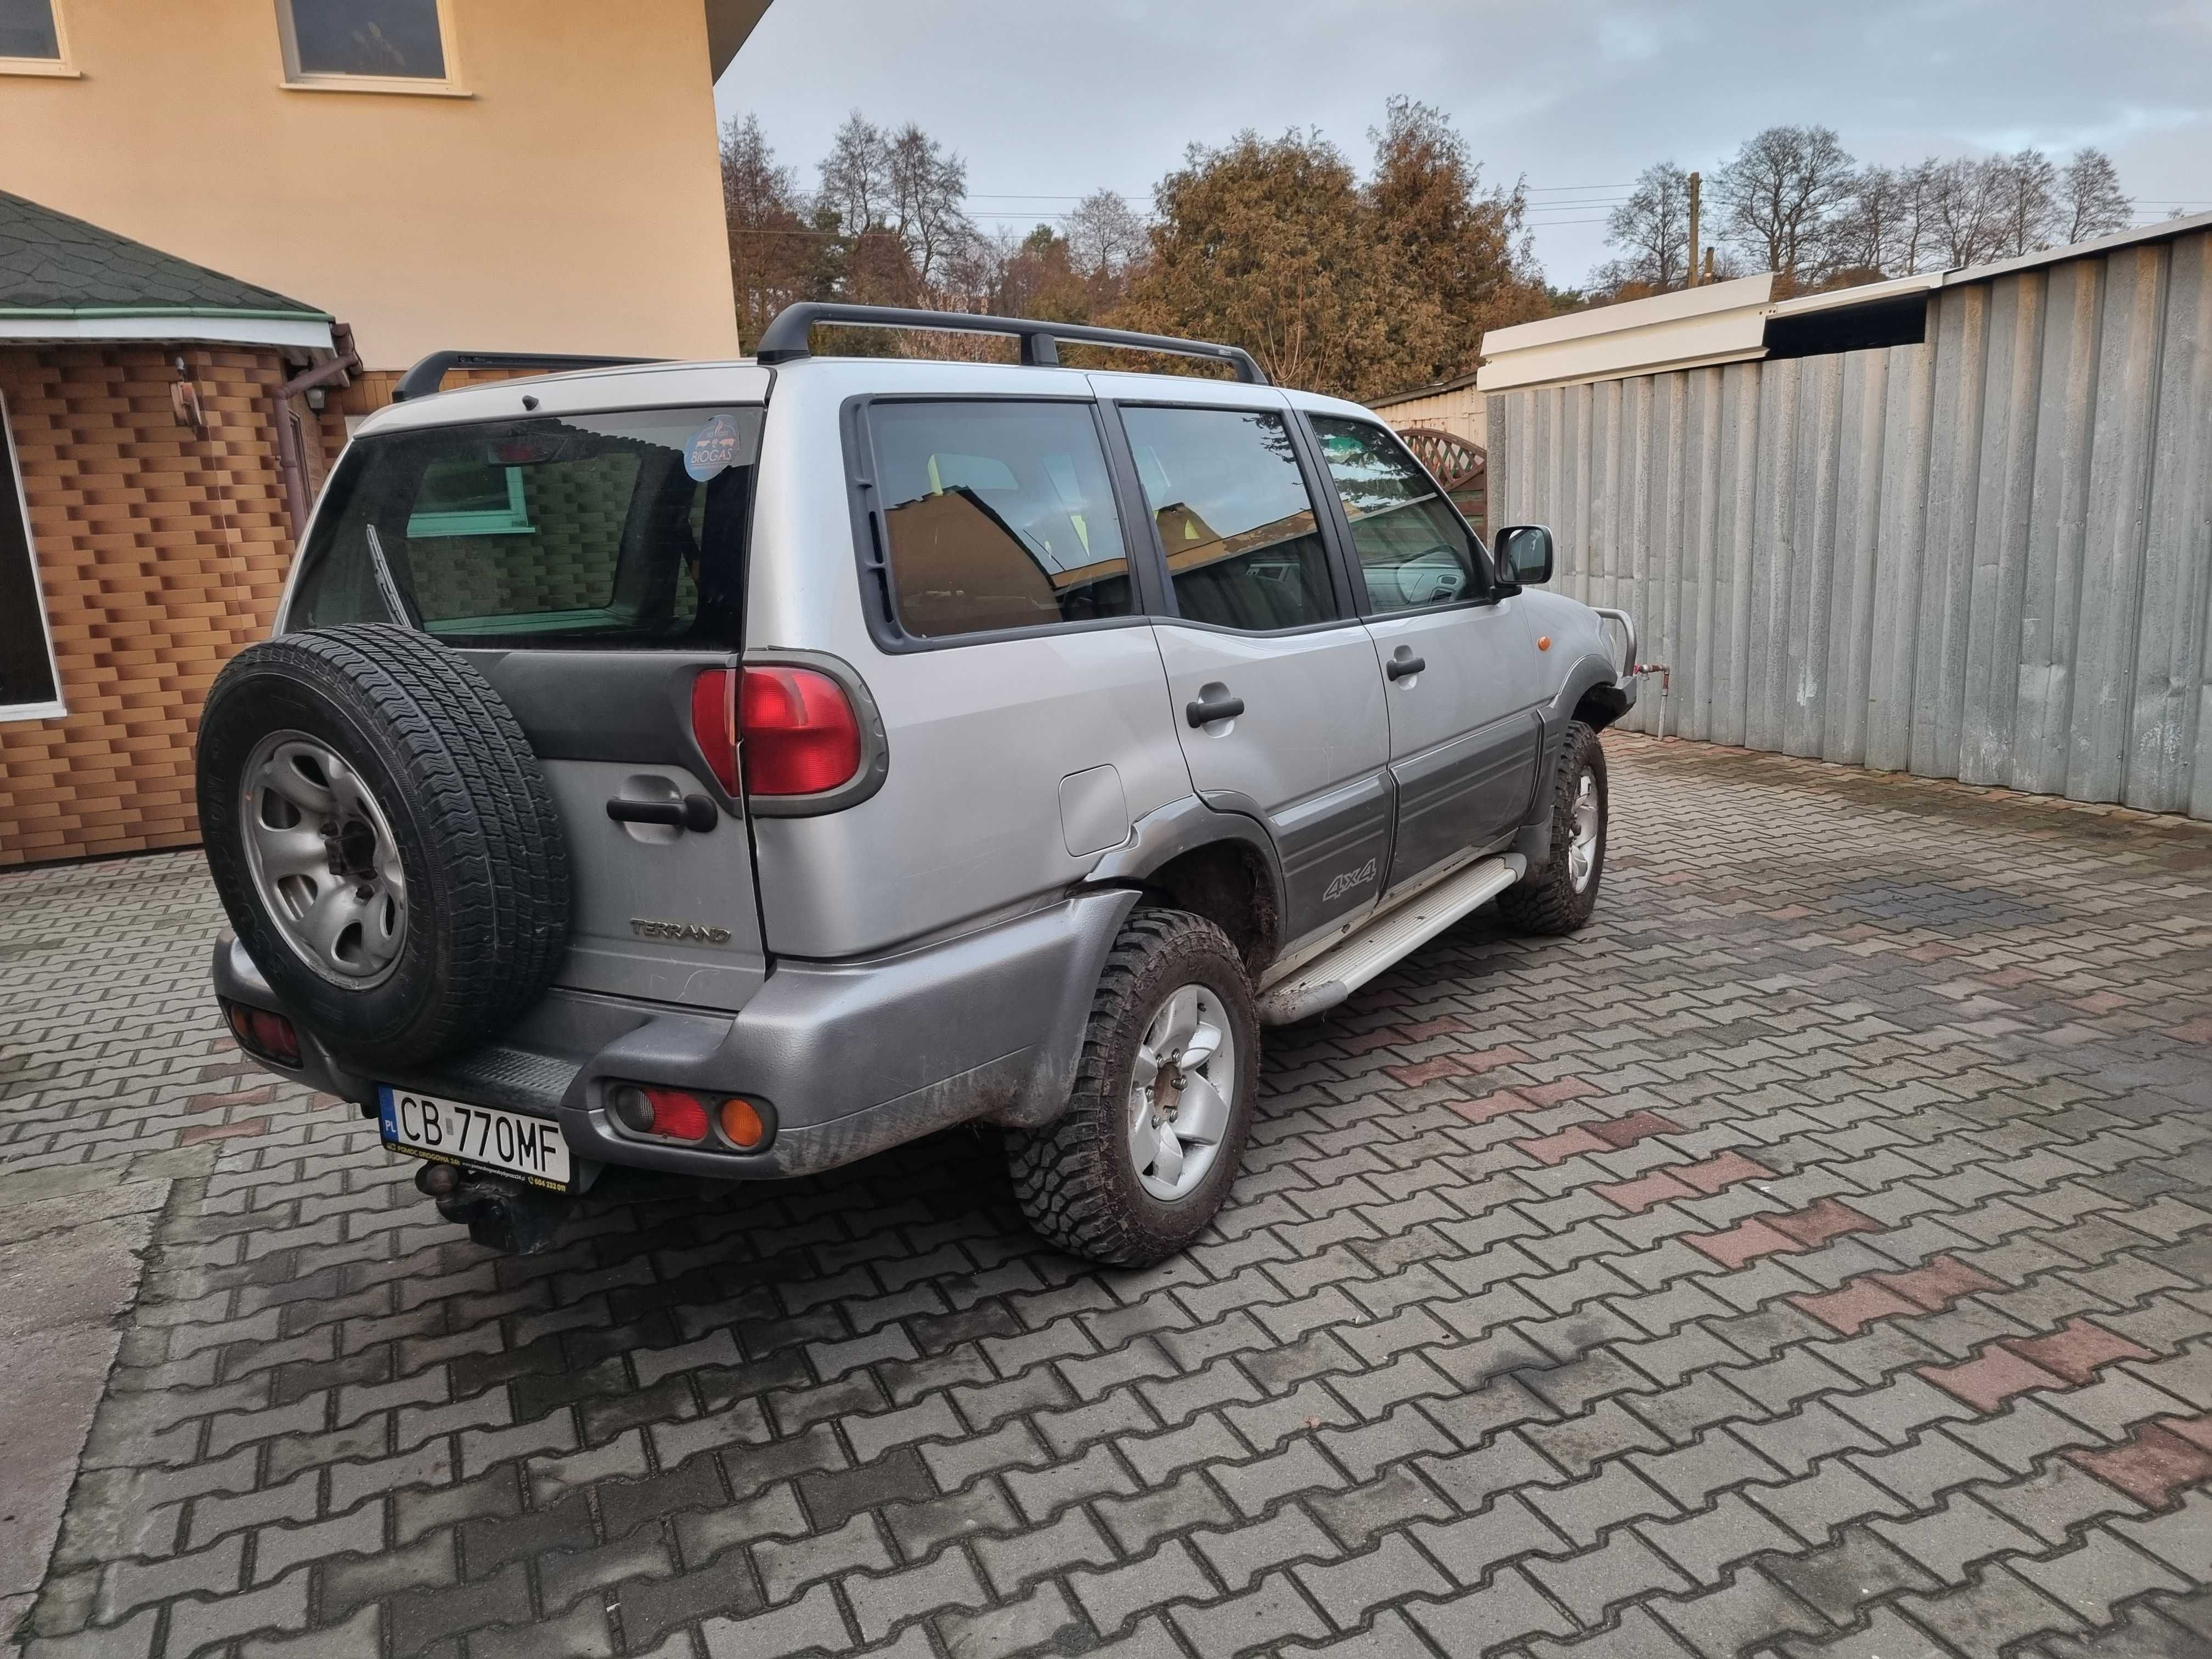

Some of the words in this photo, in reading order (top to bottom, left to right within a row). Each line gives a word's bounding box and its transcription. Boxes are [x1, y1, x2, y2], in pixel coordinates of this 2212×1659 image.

[691, 448, 732, 463] BIOGAS
[1322, 857, 1376, 902] 4x4
[629, 918, 731, 943] TERRANO
[385, 1119, 396, 1132] PL
[401, 1097, 443, 1146] CB
[454, 1106, 558, 1172] 770MF
[397, 1146, 419, 1156] POMOC
[419, 1151, 449, 1163] DROGOWA
[534, 1178, 546, 1187] 604
[546, 1182, 557, 1190] 232
